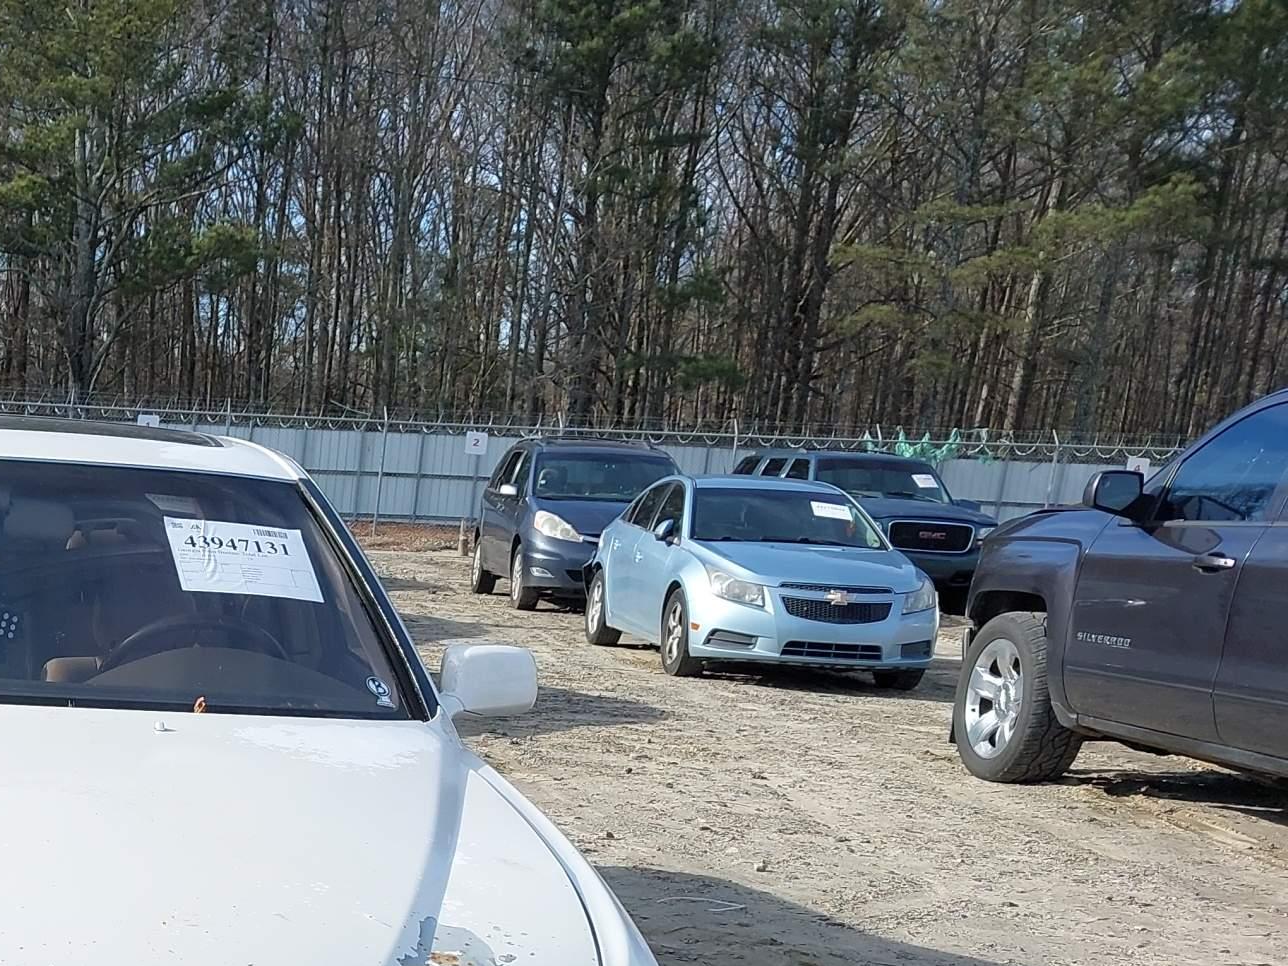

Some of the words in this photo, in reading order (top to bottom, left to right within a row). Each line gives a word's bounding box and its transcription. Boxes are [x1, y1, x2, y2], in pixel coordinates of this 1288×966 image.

[472, 438, 480, 447] 2
[919, 531, 946, 540] GMC
[184, 534, 289, 556] 43947131
[1077, 631, 1131, 647] SILVERADO
